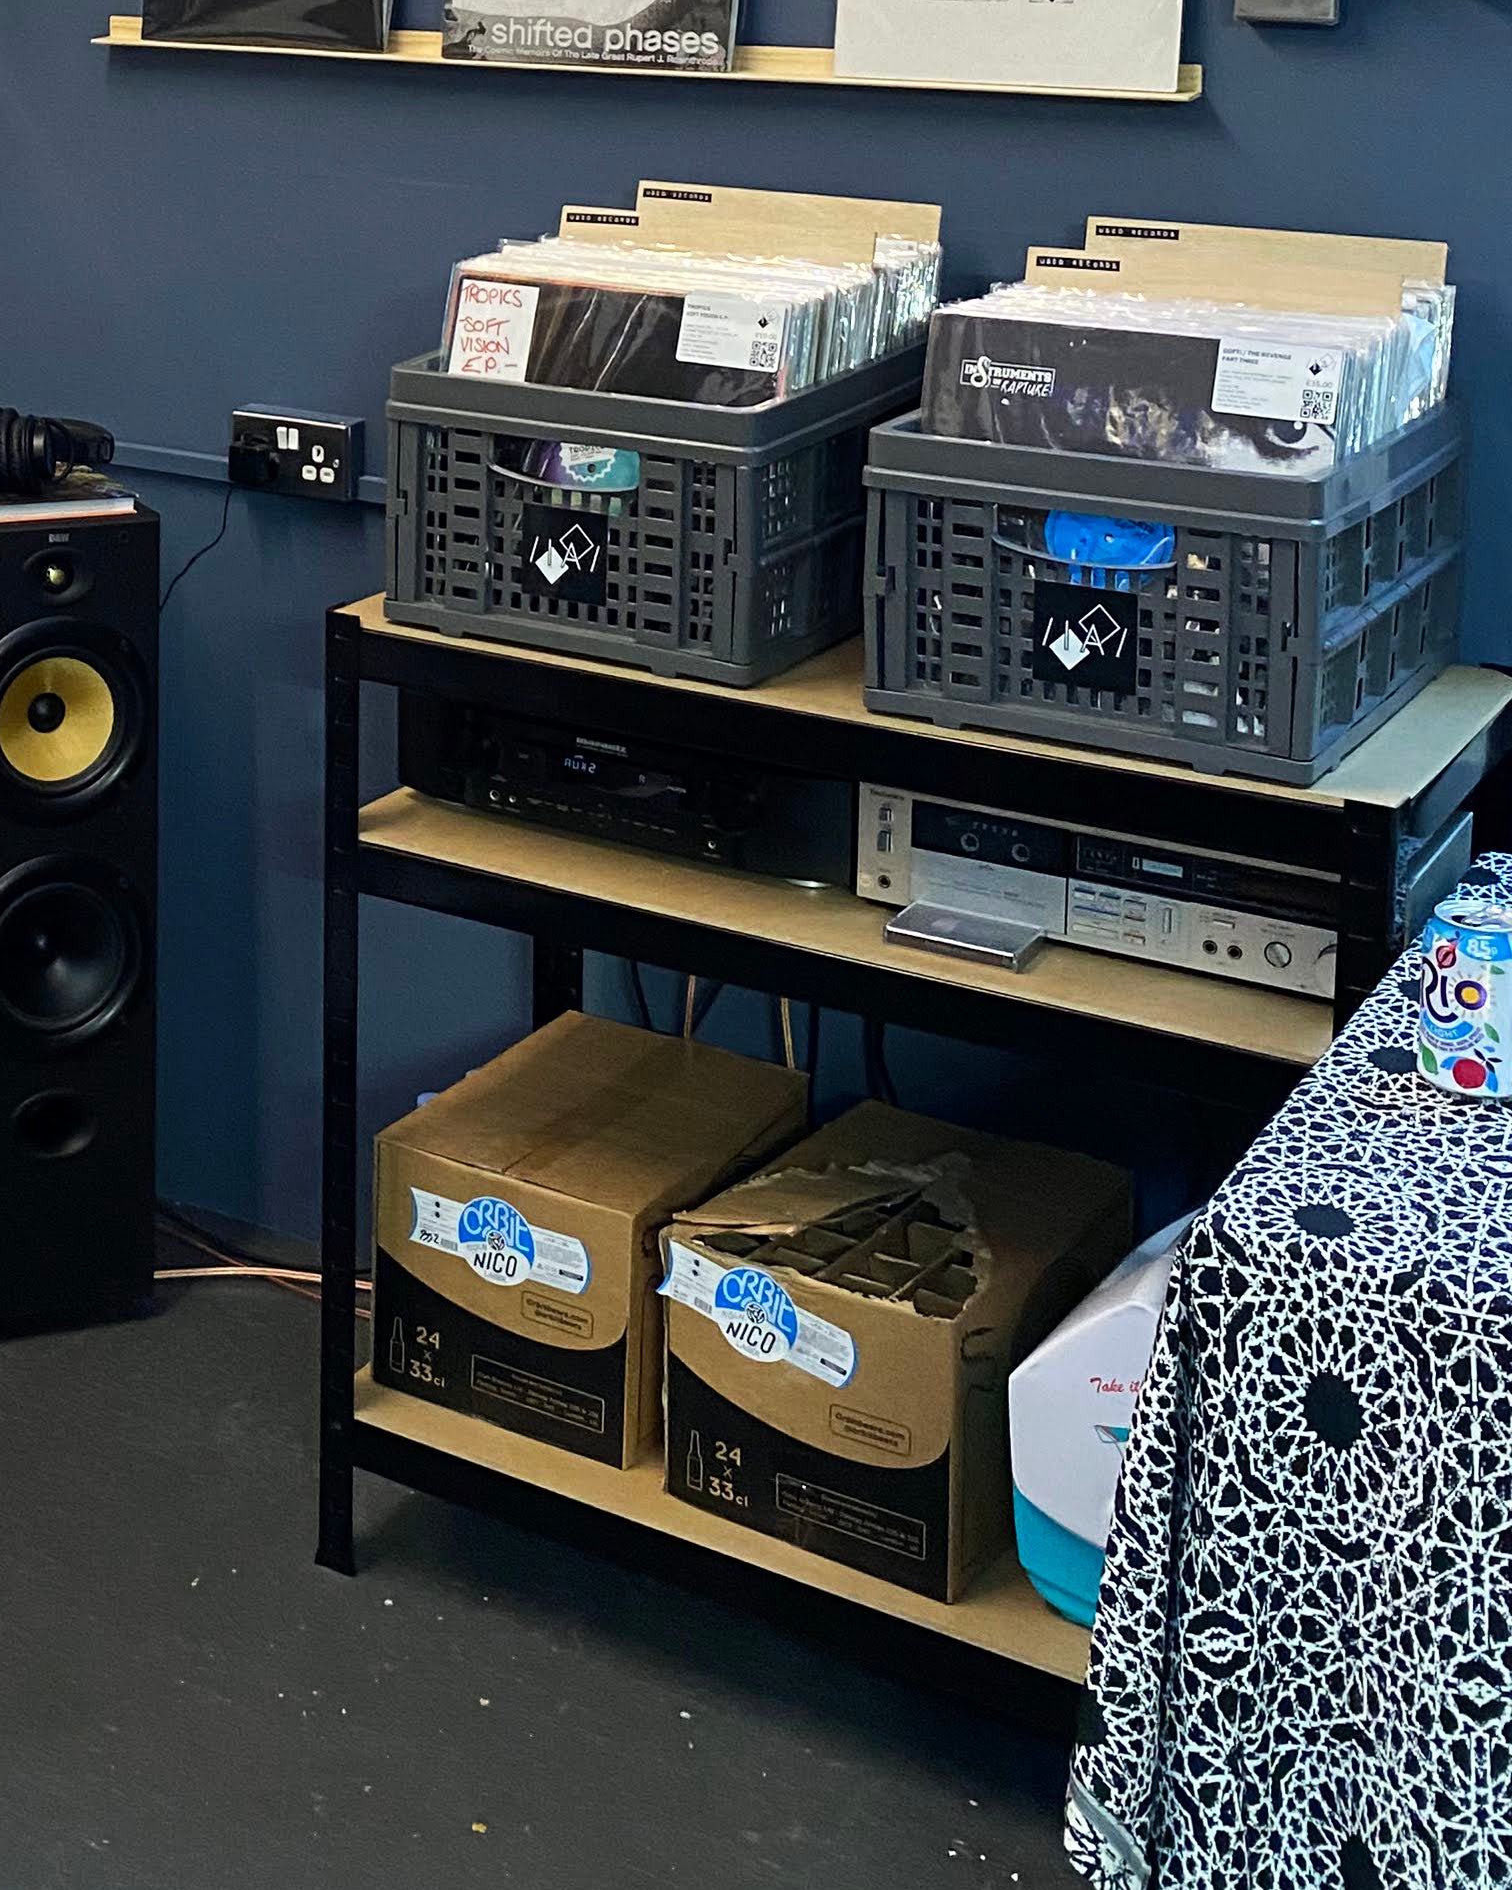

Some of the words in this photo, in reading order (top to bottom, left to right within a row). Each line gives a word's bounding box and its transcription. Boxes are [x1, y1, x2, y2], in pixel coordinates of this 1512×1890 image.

[491, 18, 593, 49] shifted
[603, 23, 721, 55] phases
[581, 49, 600, 59] Late
[601, 50, 625, 61] Great
[626, 52, 656, 63] Rupert
[462, 282, 523, 307] TROPICS
[461, 336, 510, 355] VISION
[473, 1251, 518, 1278] NICO
[415, 1326, 441, 1350] 24
[726, 1321, 776, 1354] NICO
[1090, 1376, 1125, 1394] Take
[715, 1441, 741, 1467] 24
